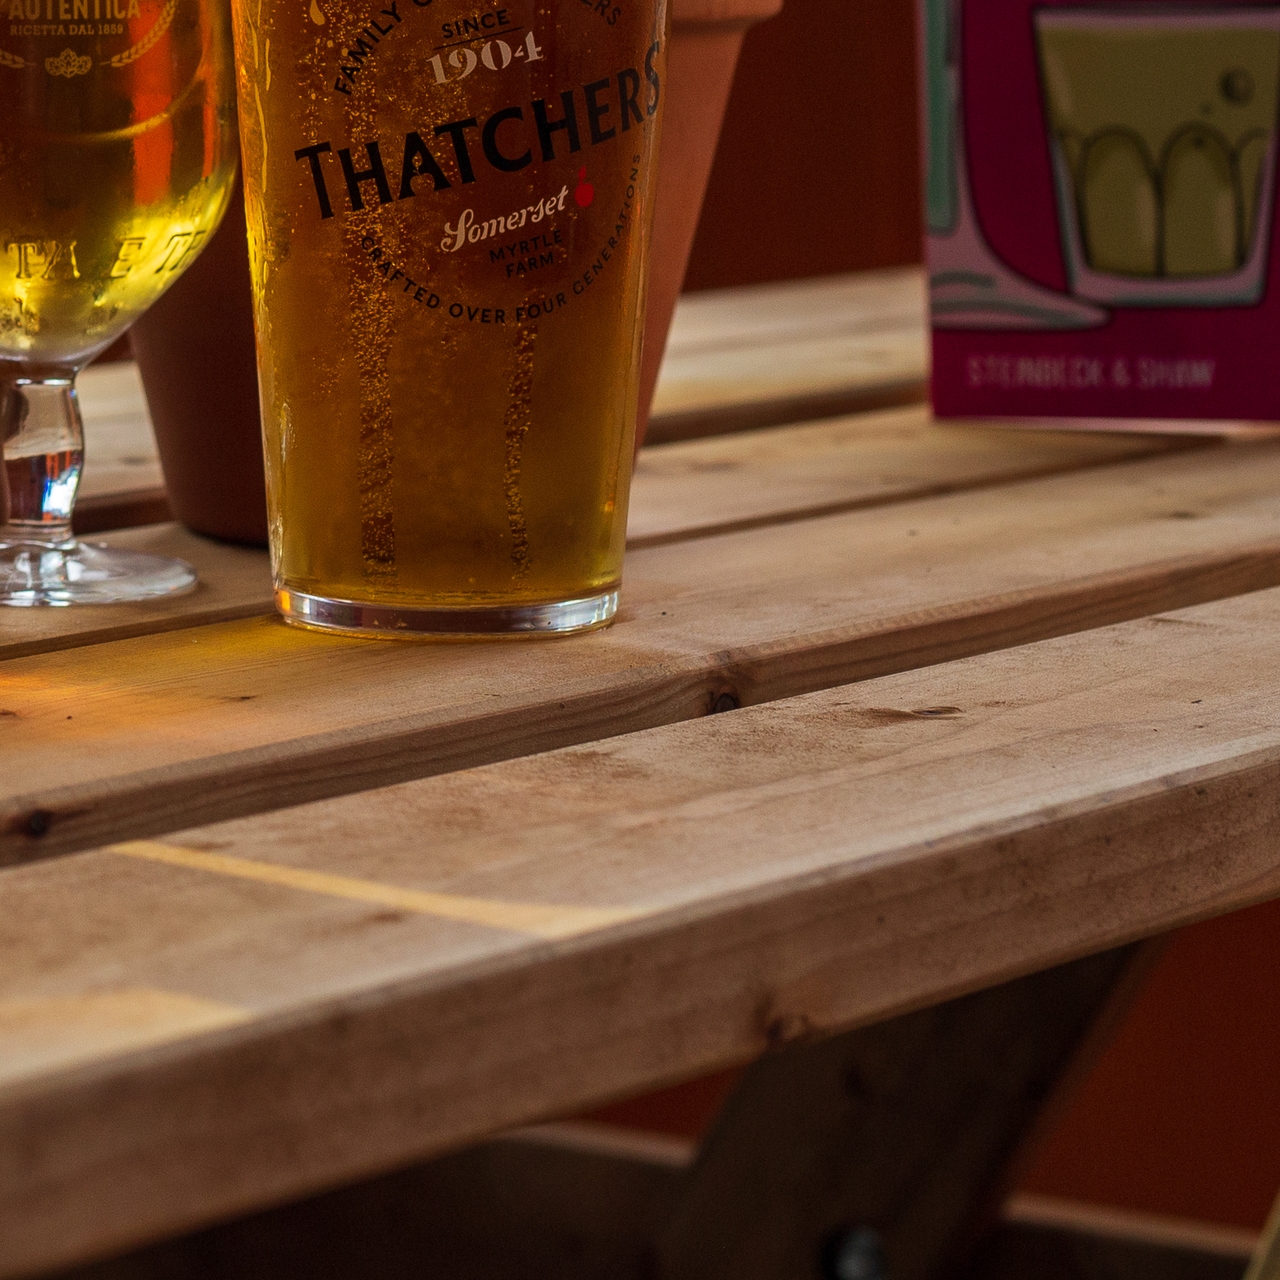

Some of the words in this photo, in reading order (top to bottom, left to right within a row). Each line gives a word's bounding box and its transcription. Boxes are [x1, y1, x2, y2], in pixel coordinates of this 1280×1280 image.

[9, 23, 68, 36] RICETTA
[69, 23, 95, 36] DAL
[334, 2, 405, 96] FAMILY
[441, 8, 512, 40] SINCE
[426, 30, 544, 86] 1904
[294, 40, 660, 219] THATCHERS
[360, 235, 440, 309] CRAFTED
[448, 302, 507, 324] OVER
[515, 290, 568, 322] FOUR
[572, 153, 641, 296] GENERATIONS
[440, 184, 570, 253] Somerset
[488, 228, 564, 264] MYRTLE
[505, 251, 555, 278] FARM
